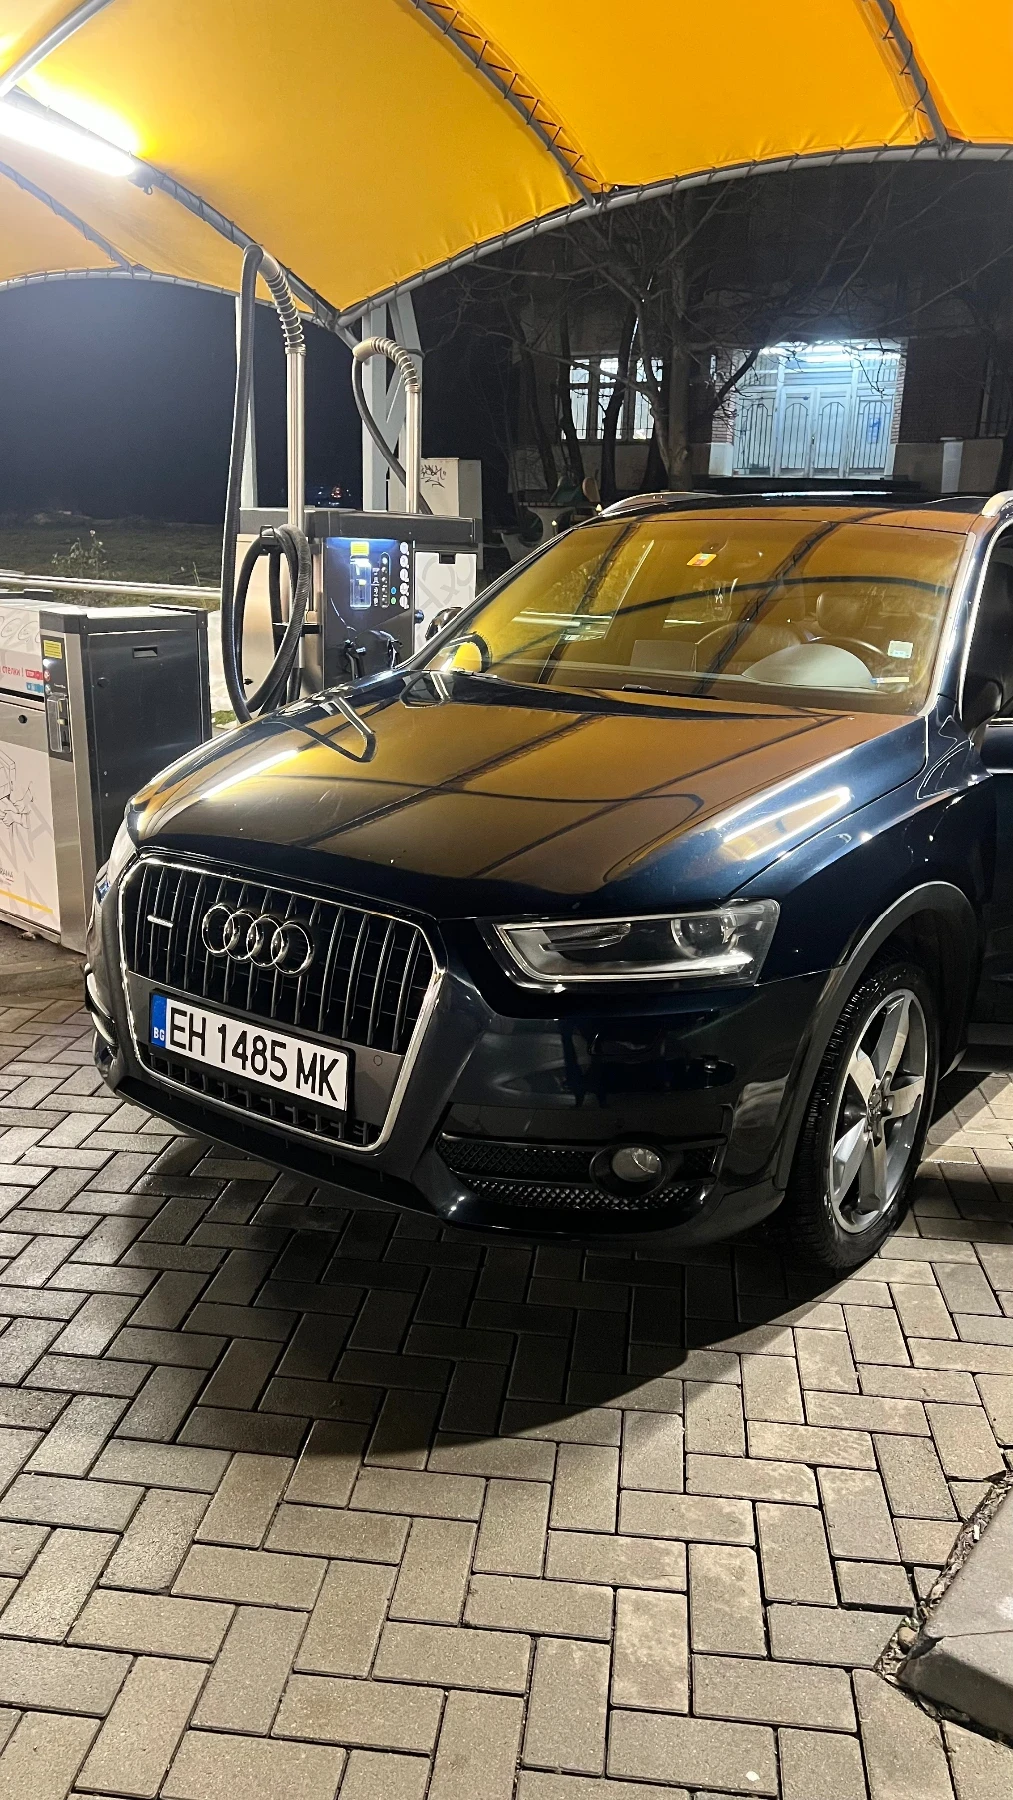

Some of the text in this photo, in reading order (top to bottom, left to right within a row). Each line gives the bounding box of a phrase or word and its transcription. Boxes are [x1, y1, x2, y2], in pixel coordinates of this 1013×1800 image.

[153, 1026, 165, 1041] BG
[170, 1006, 340, 1102] EH 1485 MK
